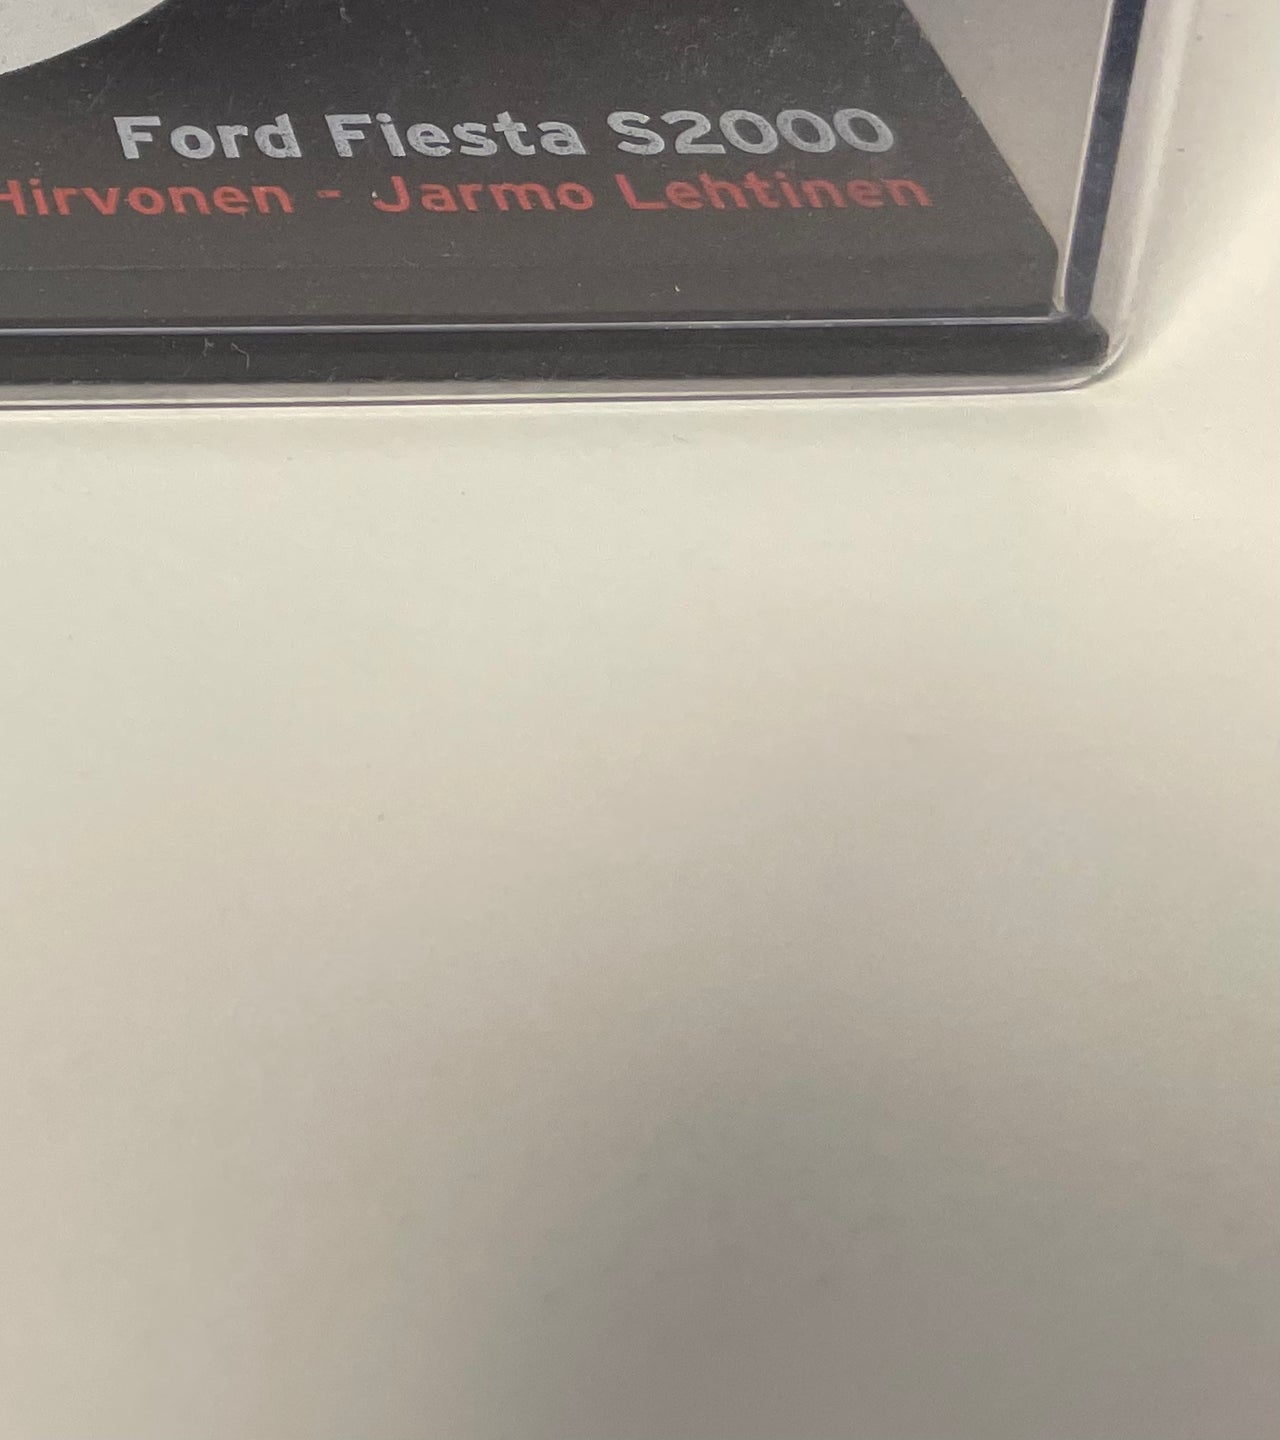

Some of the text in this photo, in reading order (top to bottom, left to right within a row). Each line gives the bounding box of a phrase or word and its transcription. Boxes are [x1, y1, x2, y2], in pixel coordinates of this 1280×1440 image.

[113, 108, 894, 160] Ford Fiesta S2000
[317, 188, 341, 199] -
[372, 176, 594, 213] Jarmo
[614, 171, 931, 211] Lehtinen
